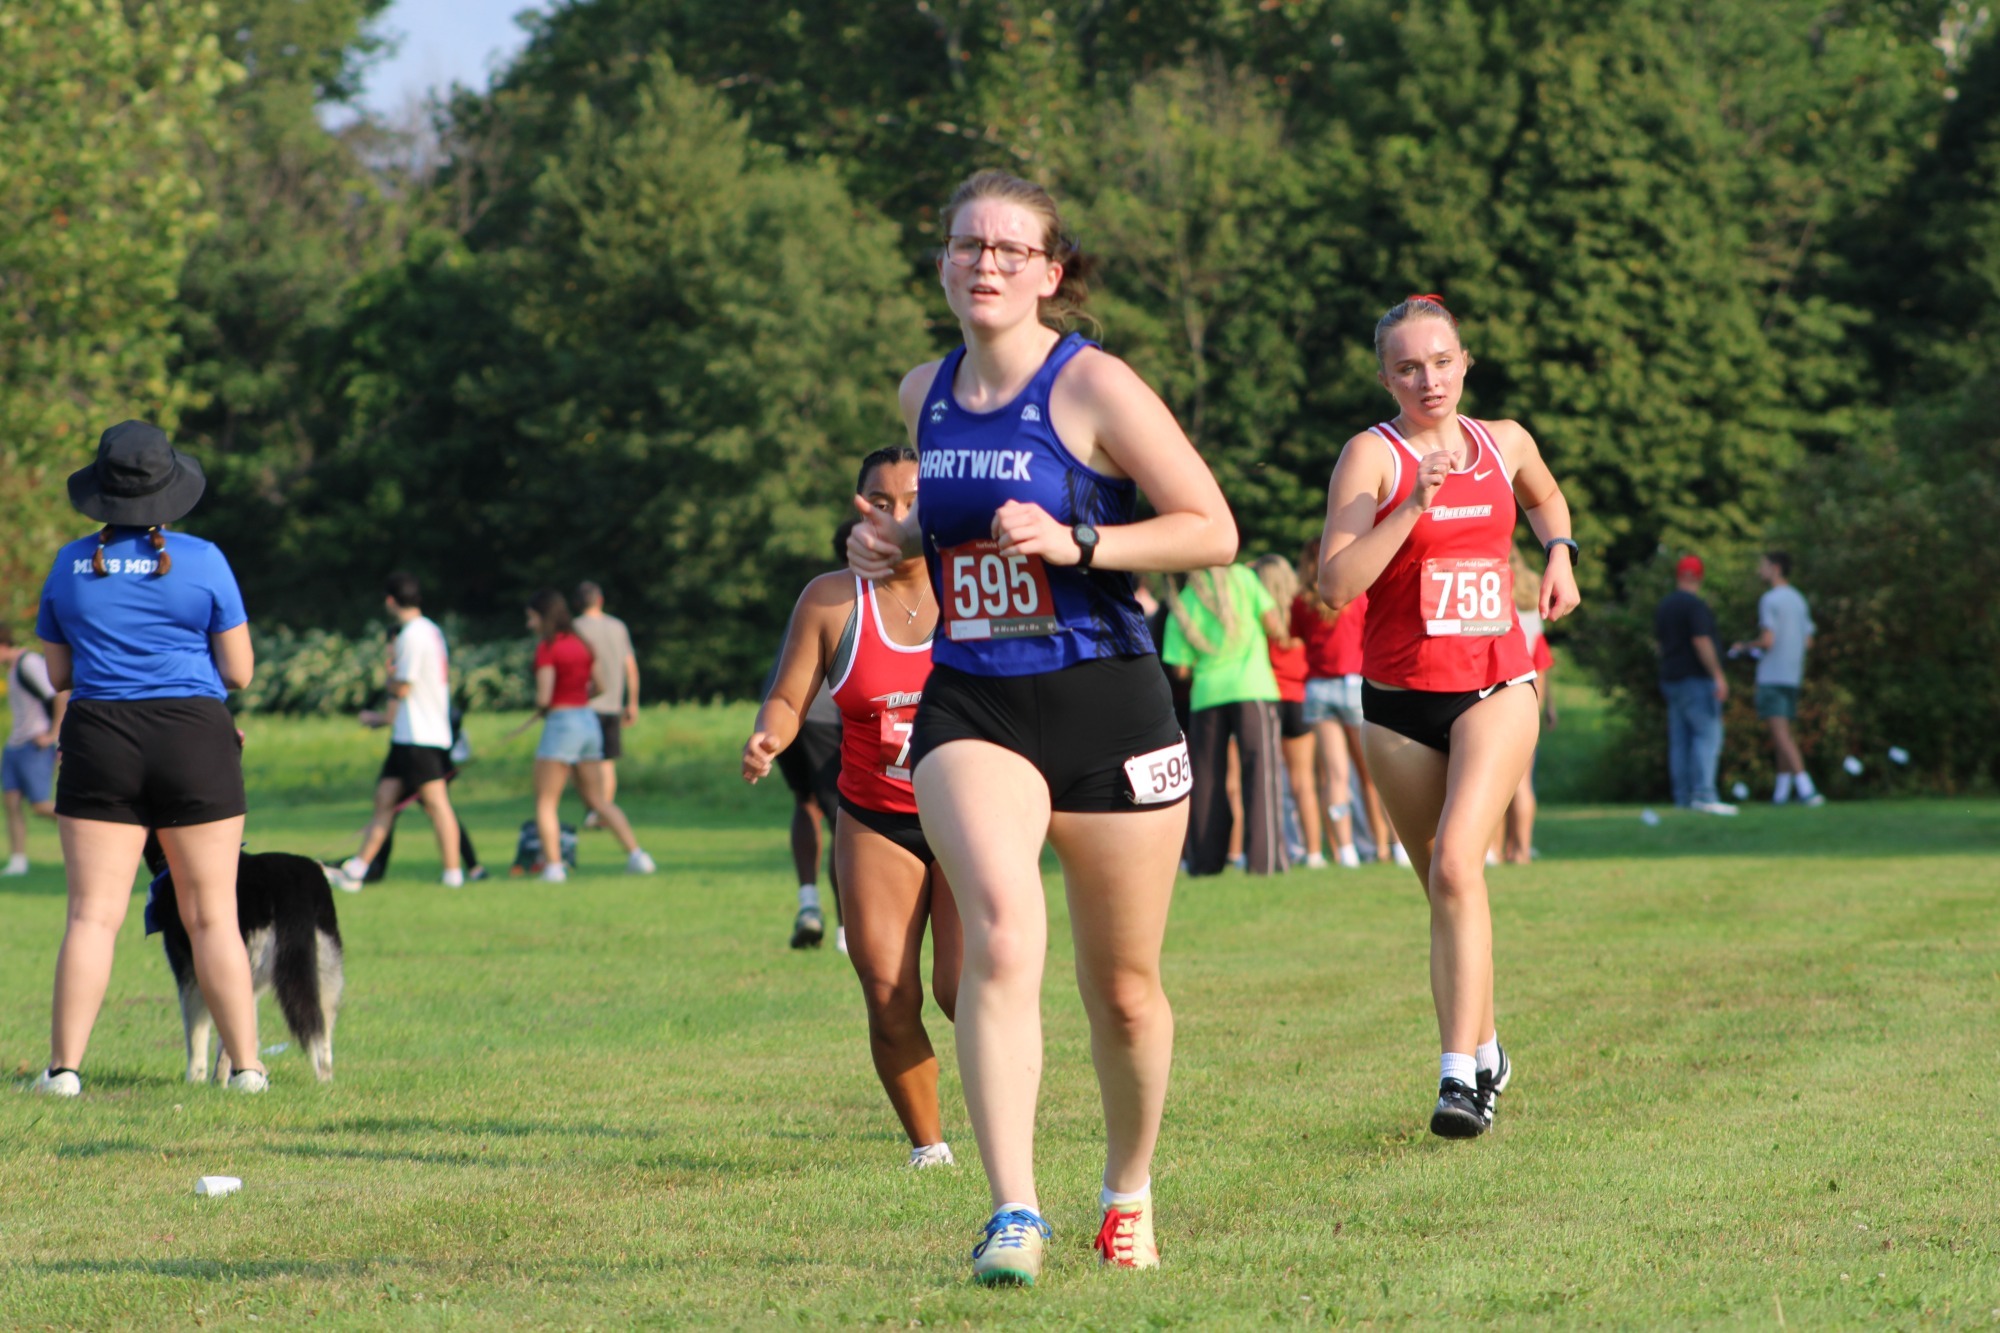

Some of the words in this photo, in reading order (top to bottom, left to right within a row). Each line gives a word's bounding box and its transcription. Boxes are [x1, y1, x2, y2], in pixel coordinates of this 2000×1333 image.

[919, 450, 1033, 481] HARTWICK
[953, 553, 1038, 618] 595
[1431, 571, 1501, 619] 758
[1148, 750, 1189, 794] 595
